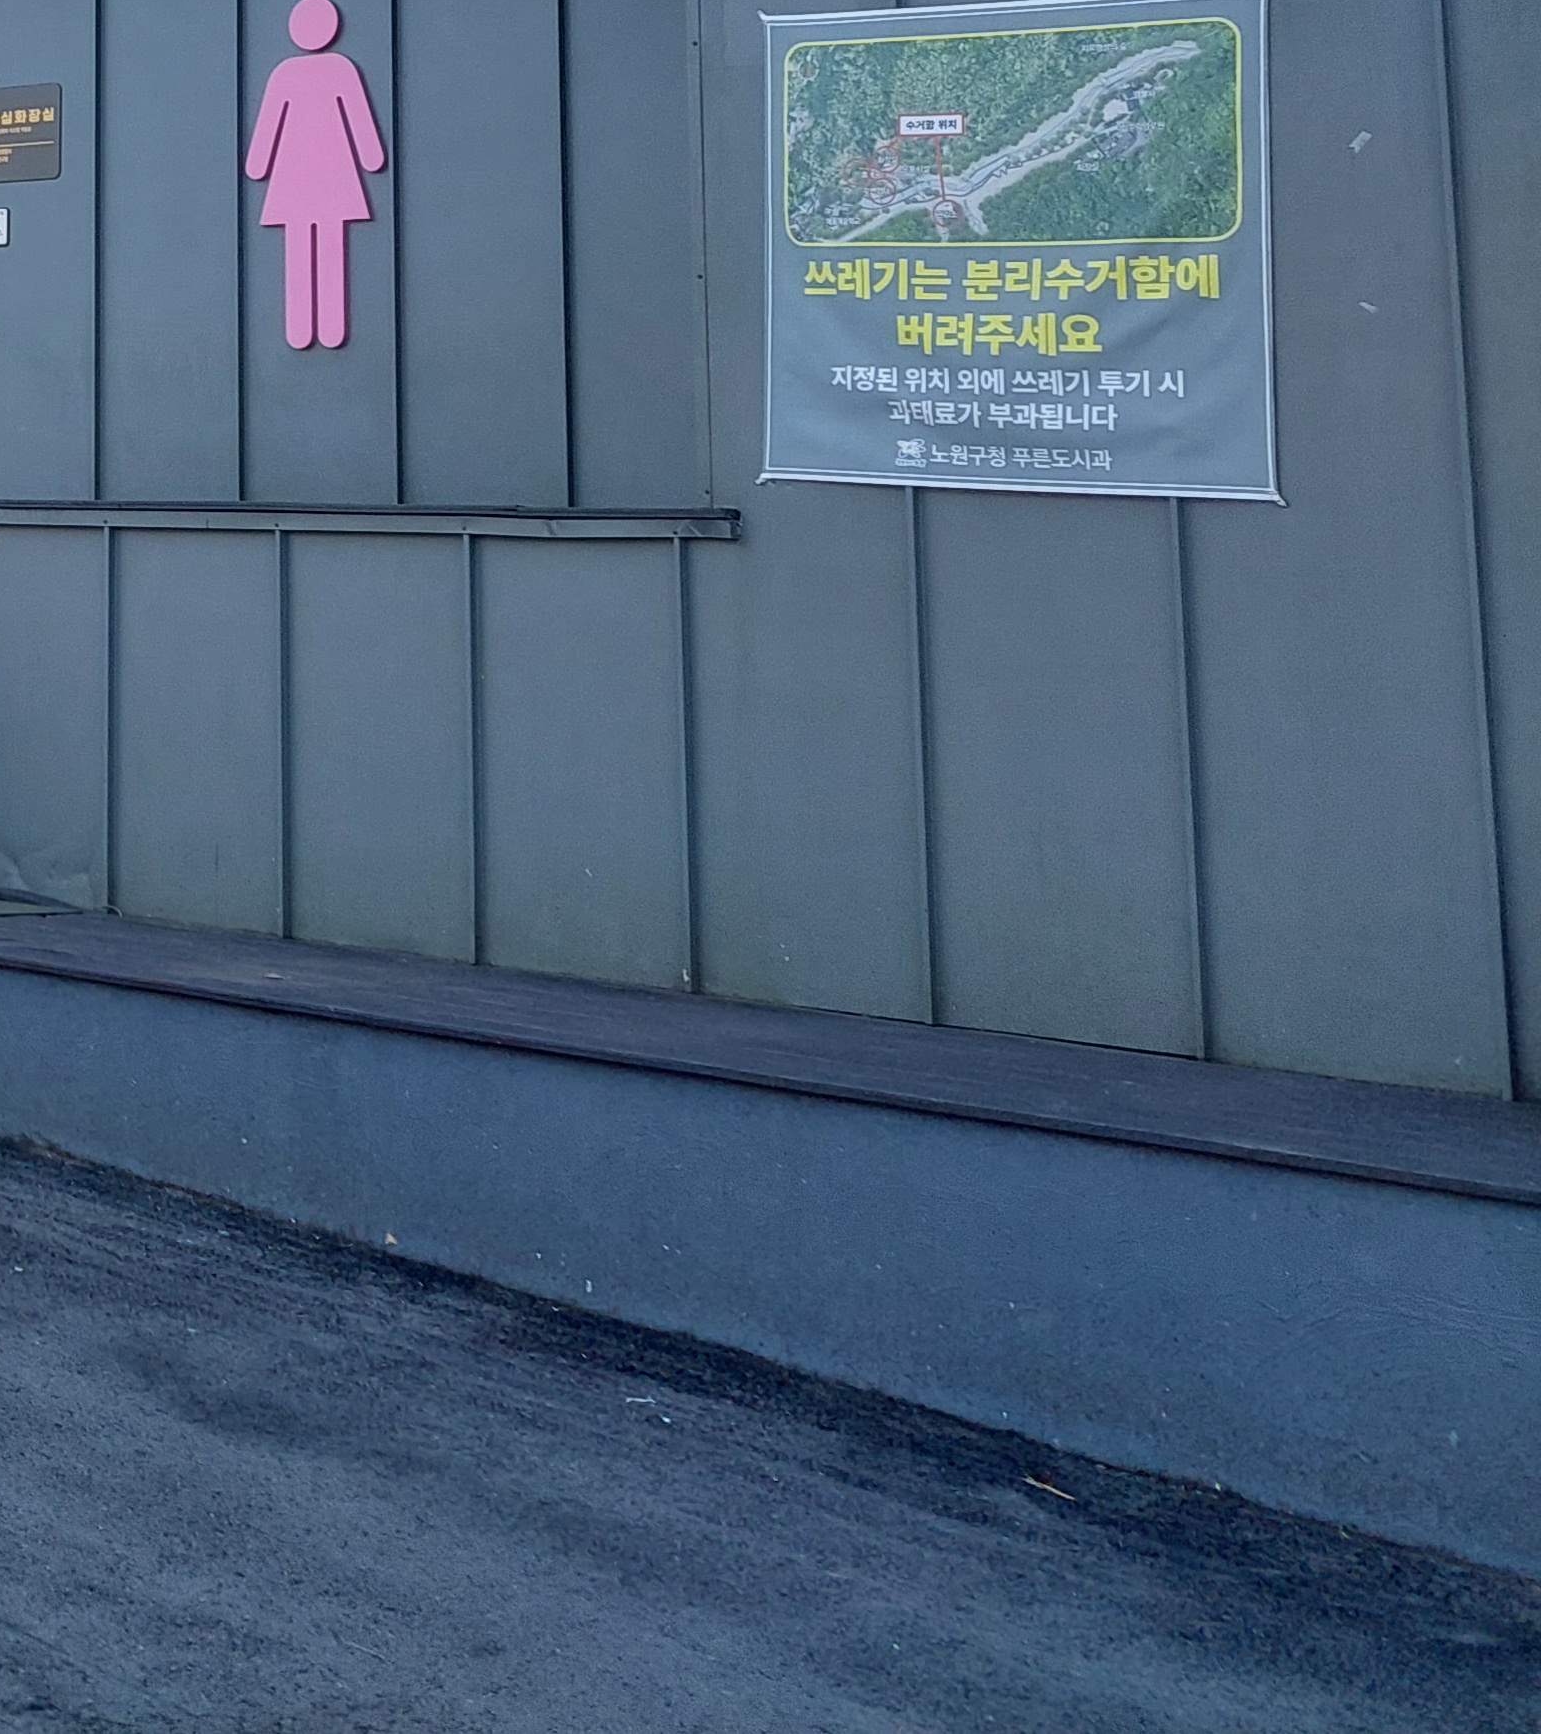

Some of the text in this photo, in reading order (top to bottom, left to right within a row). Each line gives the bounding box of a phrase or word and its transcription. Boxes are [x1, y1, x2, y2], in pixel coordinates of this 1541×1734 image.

[803, 254, 1221, 301] 쓰레기는 분리수거함에
[896, 312, 1103, 357] 버려주세요
[830, 366, 1186, 398] 지정된 위치 외에 쓰레기 투기 시
[887, 400, 1119, 432] 과태료가 부과됩니다
[929, 443, 1007, 468] 노원구청
[1011, 446, 1113, 472] 푸른도시과
